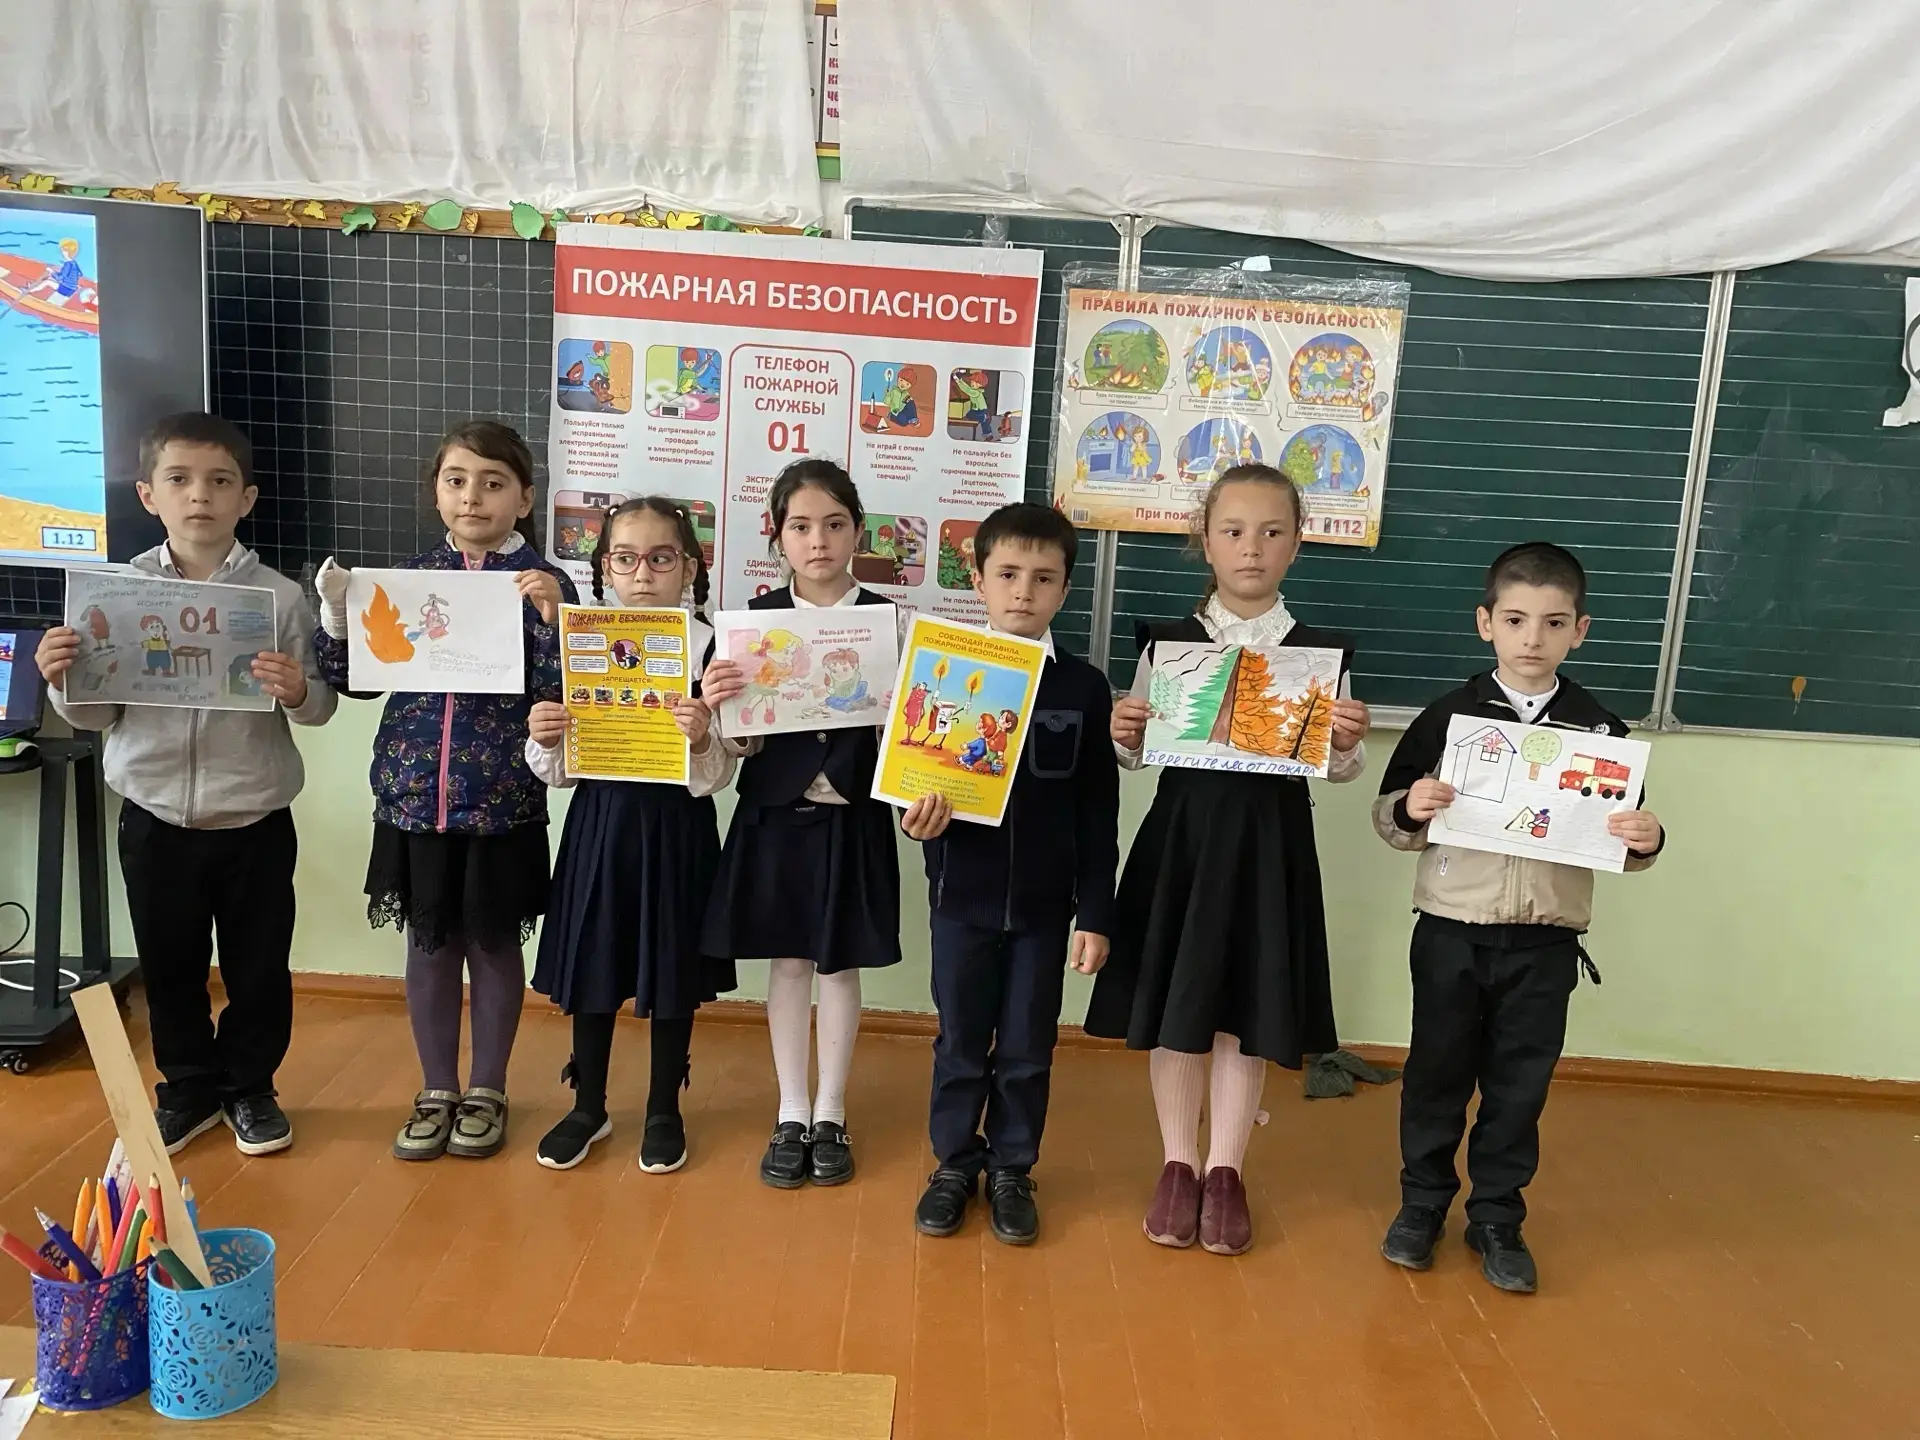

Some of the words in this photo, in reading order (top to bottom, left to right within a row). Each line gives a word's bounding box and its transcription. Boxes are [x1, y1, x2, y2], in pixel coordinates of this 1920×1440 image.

[572, 267, 756, 307] ПОЖАРНАЯ
[767, 281, 1018, 325] БЕЗОПАСНОСТЬ
[1082, 296, 1159, 315] ПРАВИЛА
[1164, 302, 1257, 322] ПОЖАРНОЙ
[754, 355, 830, 374] ТЕЛЕФОН
[744, 375, 839, 396] ПОЖАРНОЙ
[754, 397, 826, 416] СЛУЖБЫ
[563, 418, 600, 428] Пользуйся
[601, 422, 625, 430] только
[571, 430, 616, 439] исправными
[657, 427, 706, 436] дотрагивайся
[664, 437, 699, 445] проводов
[767, 421, 810, 454] 01
[558, 439, 629, 450] электроприборами!
[866, 441, 876, 449] Не
[876, 443, 897, 451] играй
[578, 450, 610, 458] оставляй
[653, 446, 715, 456] электроприборов
[963, 449, 999, 458] пользуйся
[1000, 451, 1012, 459] без
[568, 459, 618, 469] включенными
[684, 458, 713, 466] руками!
[870, 462, 918, 472] зажигалками,
[965, 460, 998, 468] взрослых
[579, 470, 620, 479] присмотра!
[940, 468, 977, 476] горючими
[741, 485, 769, 497] СПЕЦИ
[952, 488, 1007, 499] растворителем,
[738, 495, 765, 504] МОБИ
[938, 496, 975, 506] бензином,
[1135, 507, 1160, 521] При
[1164, 510, 1190, 520] пож
[1333, 519, 1362, 534] 112
[52, 532, 85, 545] 1.12
[746, 559, 781, 569] ЕДИНЫЙ
[743, 569, 778, 579] СЛУЖБЫ
[943, 596, 952, 604] Не
[953, 597, 988, 607] пользуйс
[898, 603, 918, 612] плиту
[931, 606, 965, 615] взрослых
[179, 606, 221, 635] 01
[567, 611, 616, 628] ПОЖАРНАЯ
[618, 613, 683, 625] БЕЗОПАСНОСТЬ
[938, 631, 984, 648] СОБЛЮДАЙ
[984, 642, 1020, 656] ПРАВИЛА
[923, 636, 967, 652] ПОЖАРНОЙ
[968, 646, 1031, 665] БЕЗОПАСНОСТИ!
